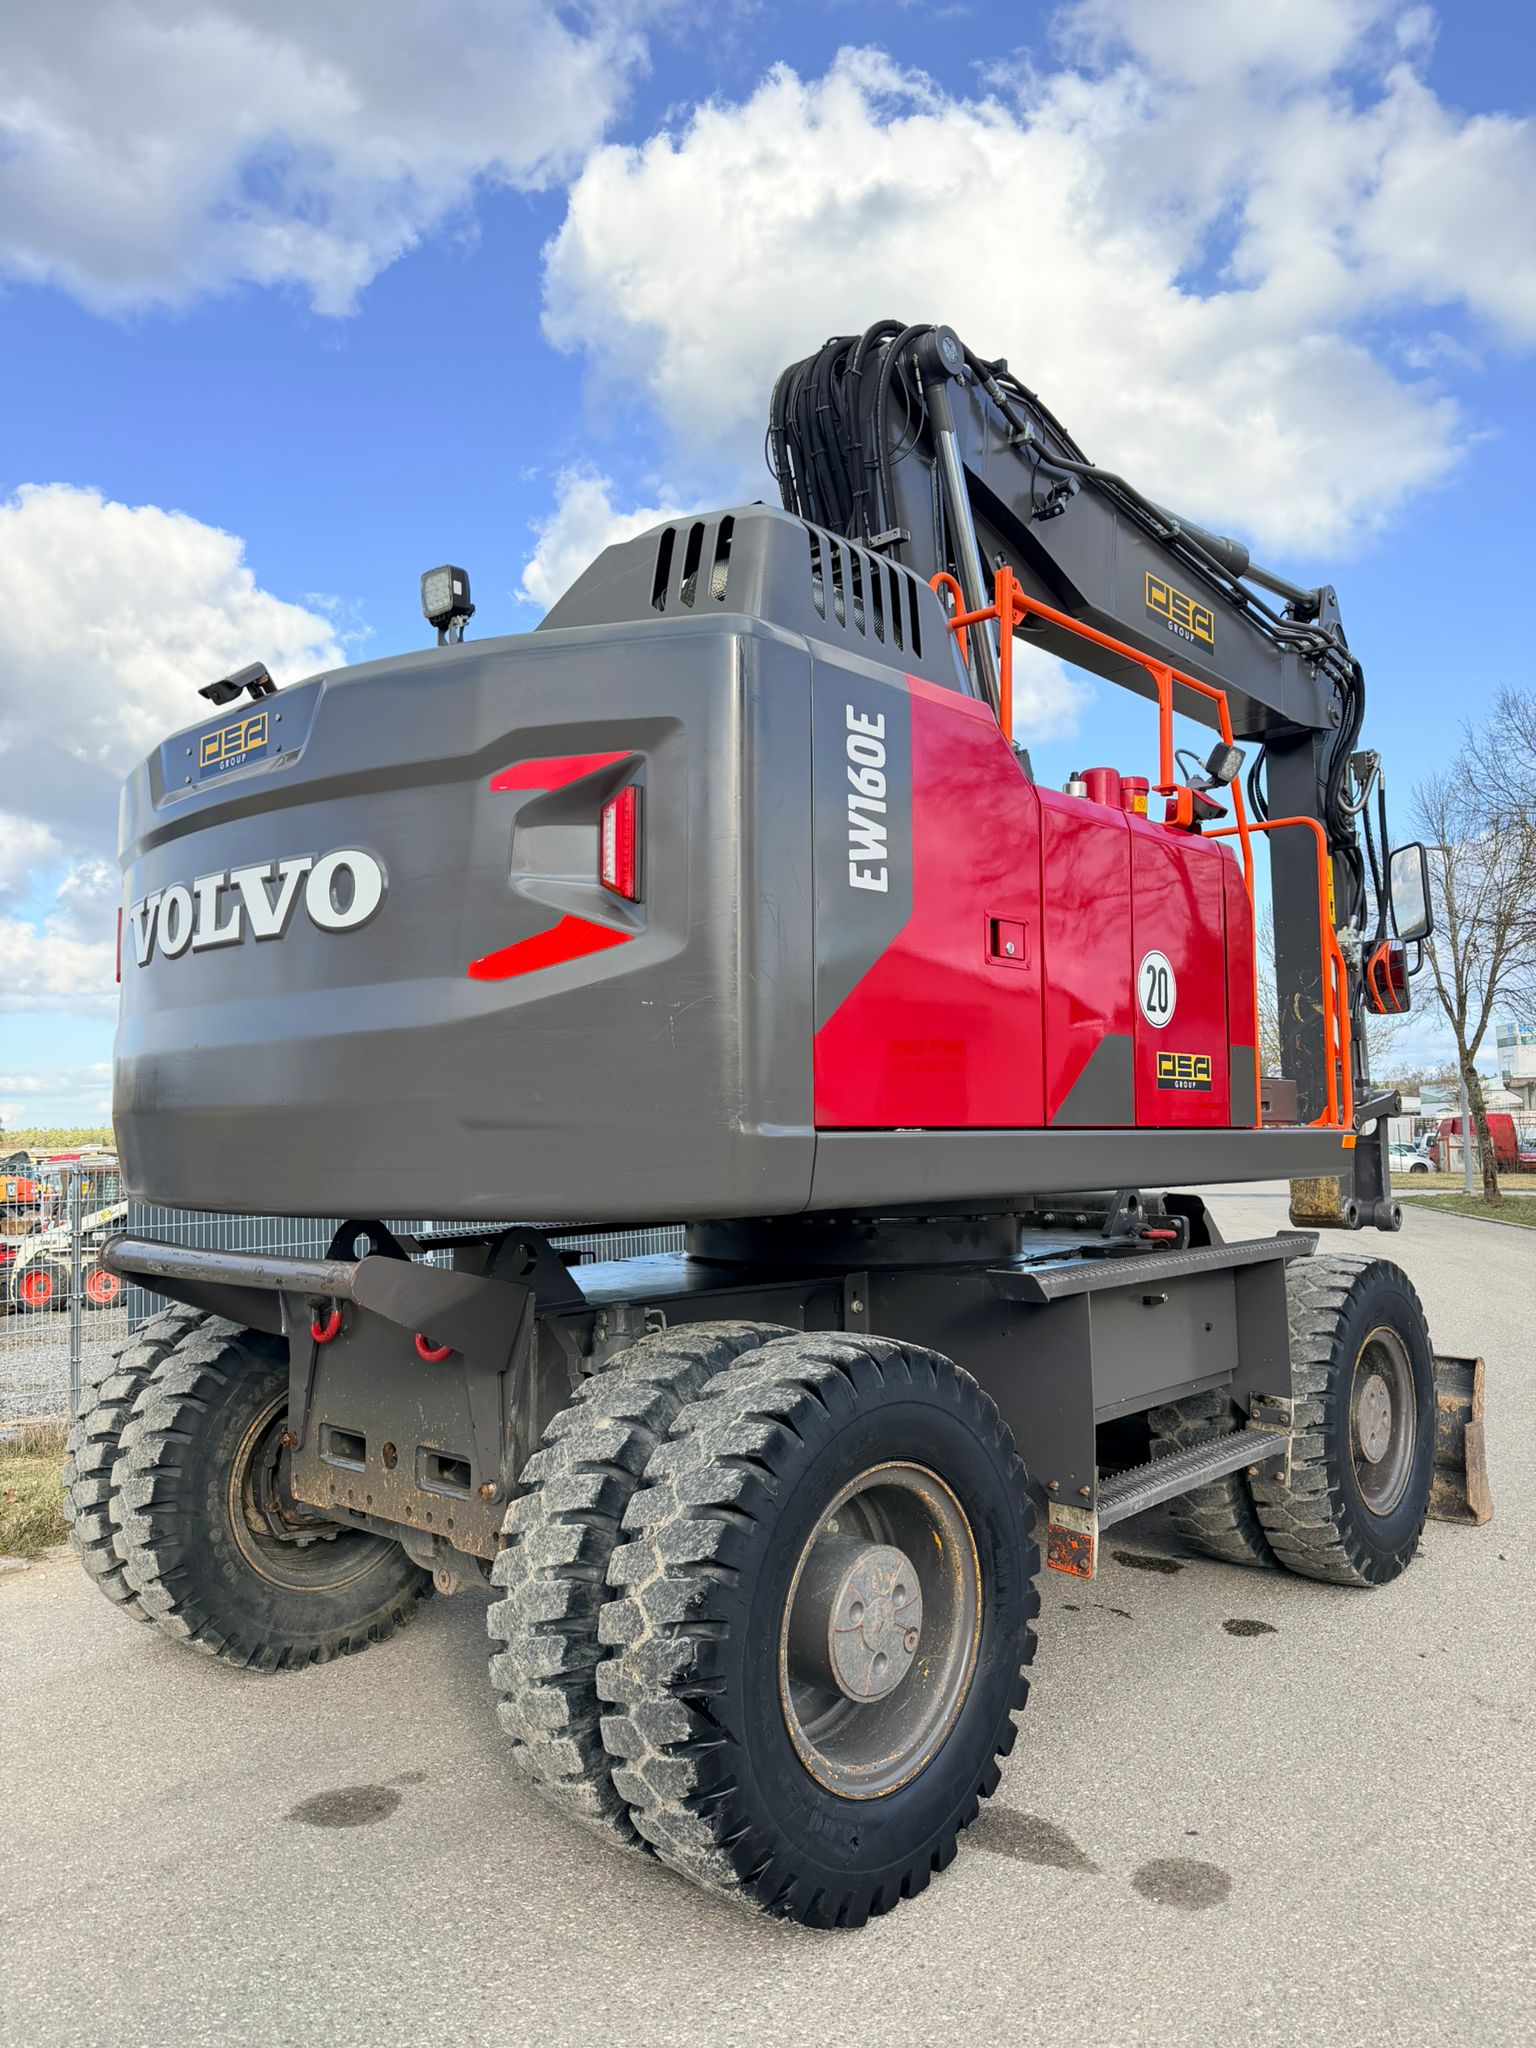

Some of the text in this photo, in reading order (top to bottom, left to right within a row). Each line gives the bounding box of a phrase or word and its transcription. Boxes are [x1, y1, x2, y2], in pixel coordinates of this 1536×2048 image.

[1167, 620, 1195, 642] GROUP
[219, 753, 247, 770] GROUP
[846, 703, 889, 893] EW160E
[130, 848, 385, 967] VOLVO
[1146, 964, 1168, 1014] 20
[1174, 1080, 1197, 1089] GROUP
